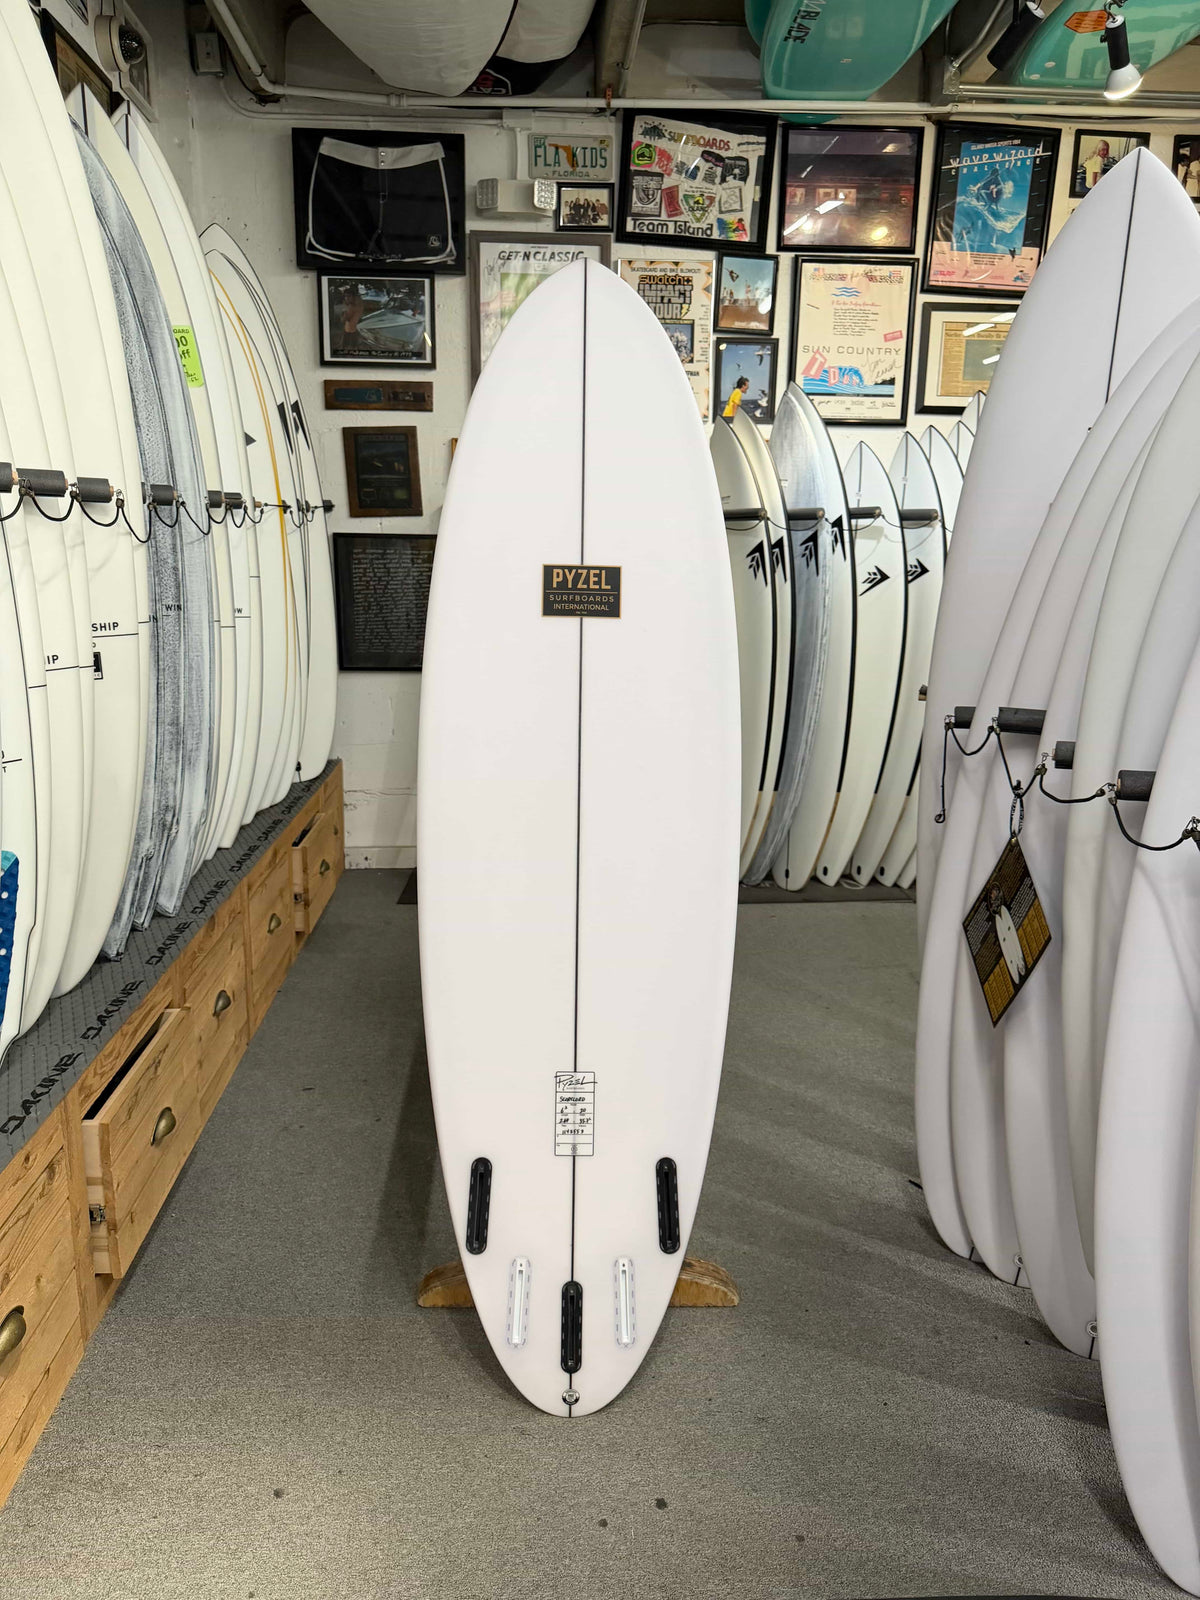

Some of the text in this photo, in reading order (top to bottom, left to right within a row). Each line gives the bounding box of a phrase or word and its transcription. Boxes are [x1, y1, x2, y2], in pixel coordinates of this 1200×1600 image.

[668, 131, 731, 152] SURFBOARDS
[534, 145, 608, 169] FLA KIDS
[552, 170, 591, 178] FLORIDA
[632, 220, 714, 238] Team Island
[533, 250, 585, 262] CLASSIC
[639, 274, 684, 285] swatch
[638, 284, 693, 304] IMPACT
[648, 303, 682, 319] TOUR
[802, 345, 901, 356] SUN COUNTRY
[552, 568, 611, 590] PYZEL
[549, 594, 615, 603] SURFBOARDS
[553, 603, 609, 611] INTERNATIONAL
[91, 621, 119, 632] SHIP
[80, 979, 145, 1041] DAKINE
[0, 1051, 84, 1136] DAKINE
